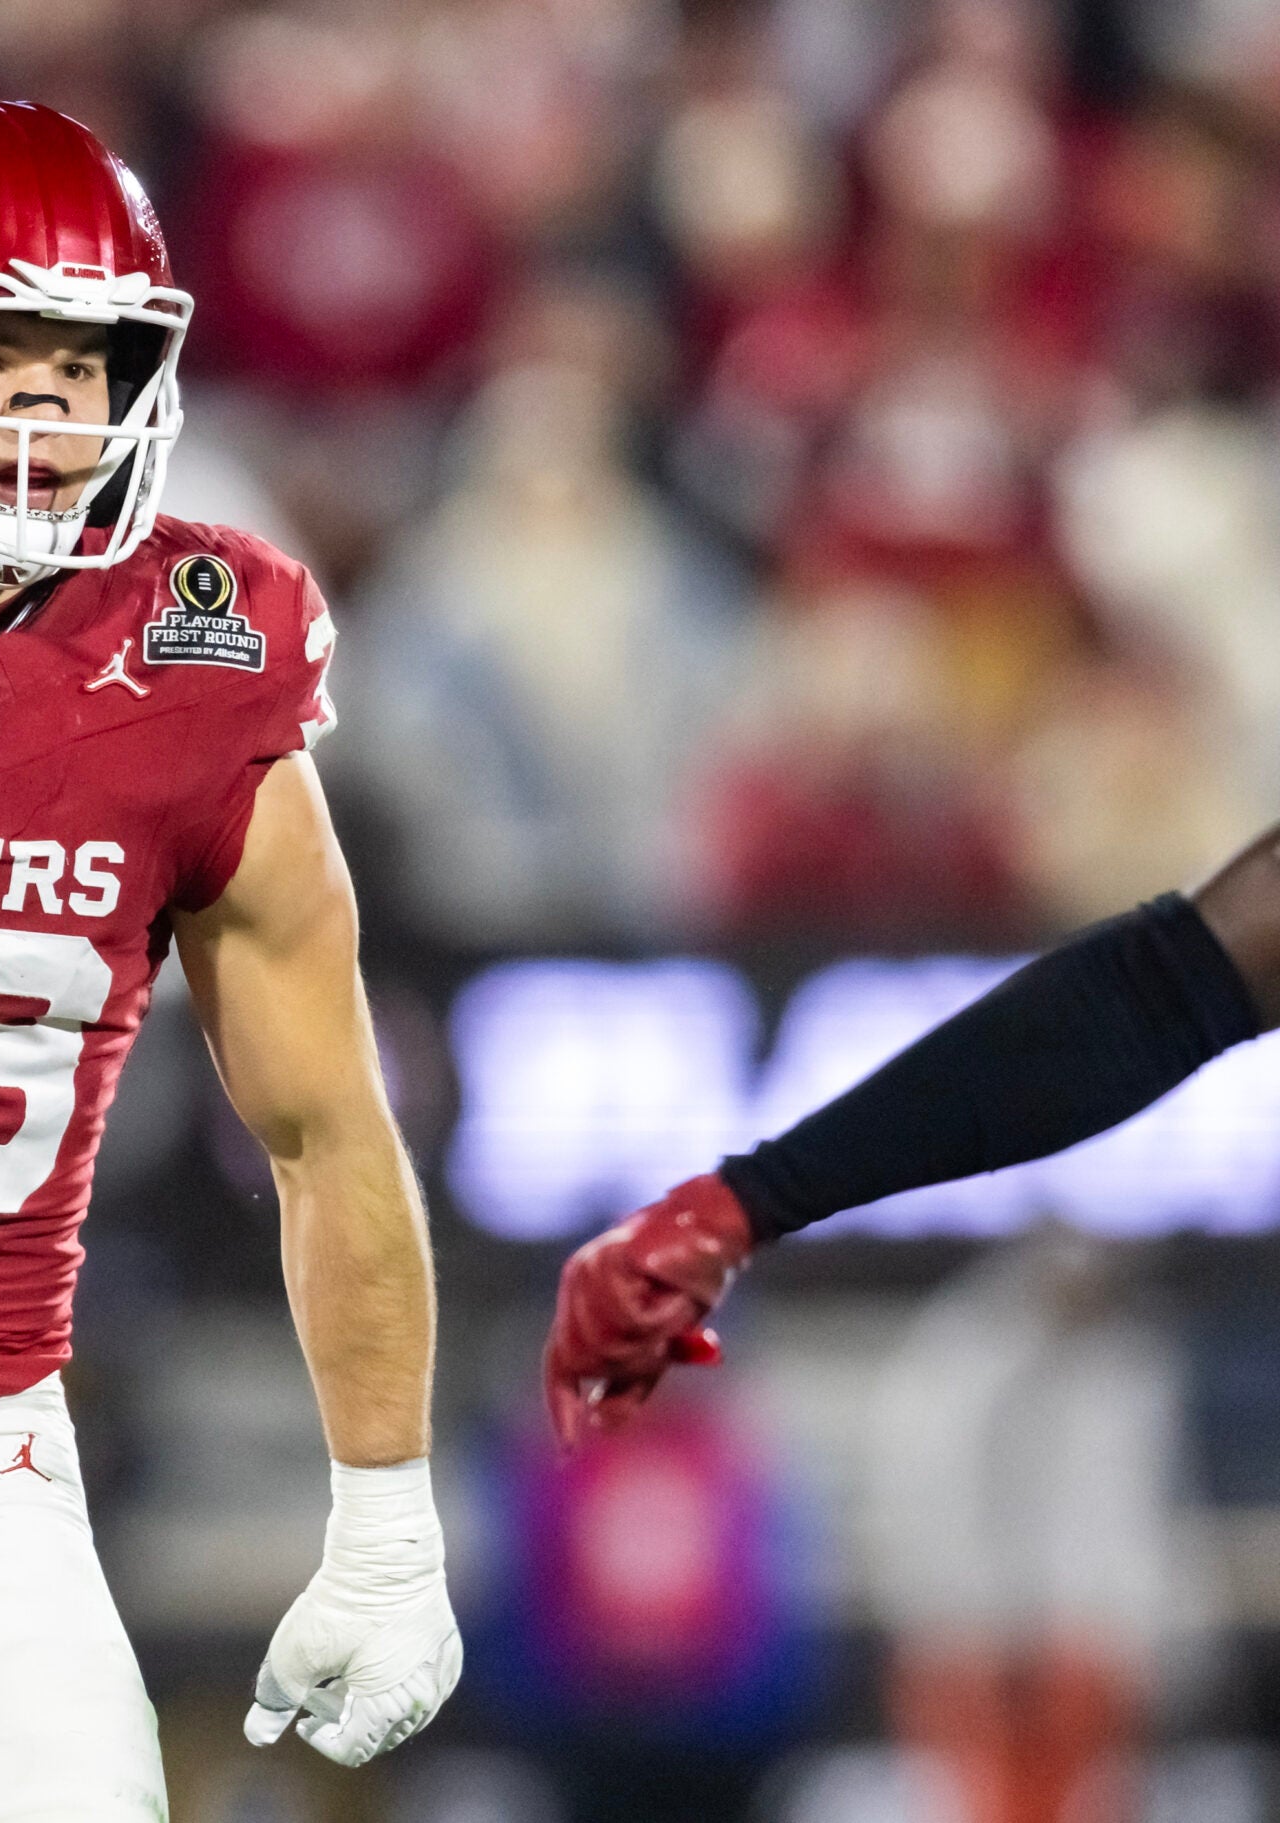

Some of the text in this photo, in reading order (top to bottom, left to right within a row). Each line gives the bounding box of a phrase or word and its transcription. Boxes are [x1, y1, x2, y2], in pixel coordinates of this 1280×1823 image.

[169, 614, 242, 632] PLAYOFF
[151, 629, 259, 649] FIRST ROUND
[214, 647, 250, 662] Allstate
